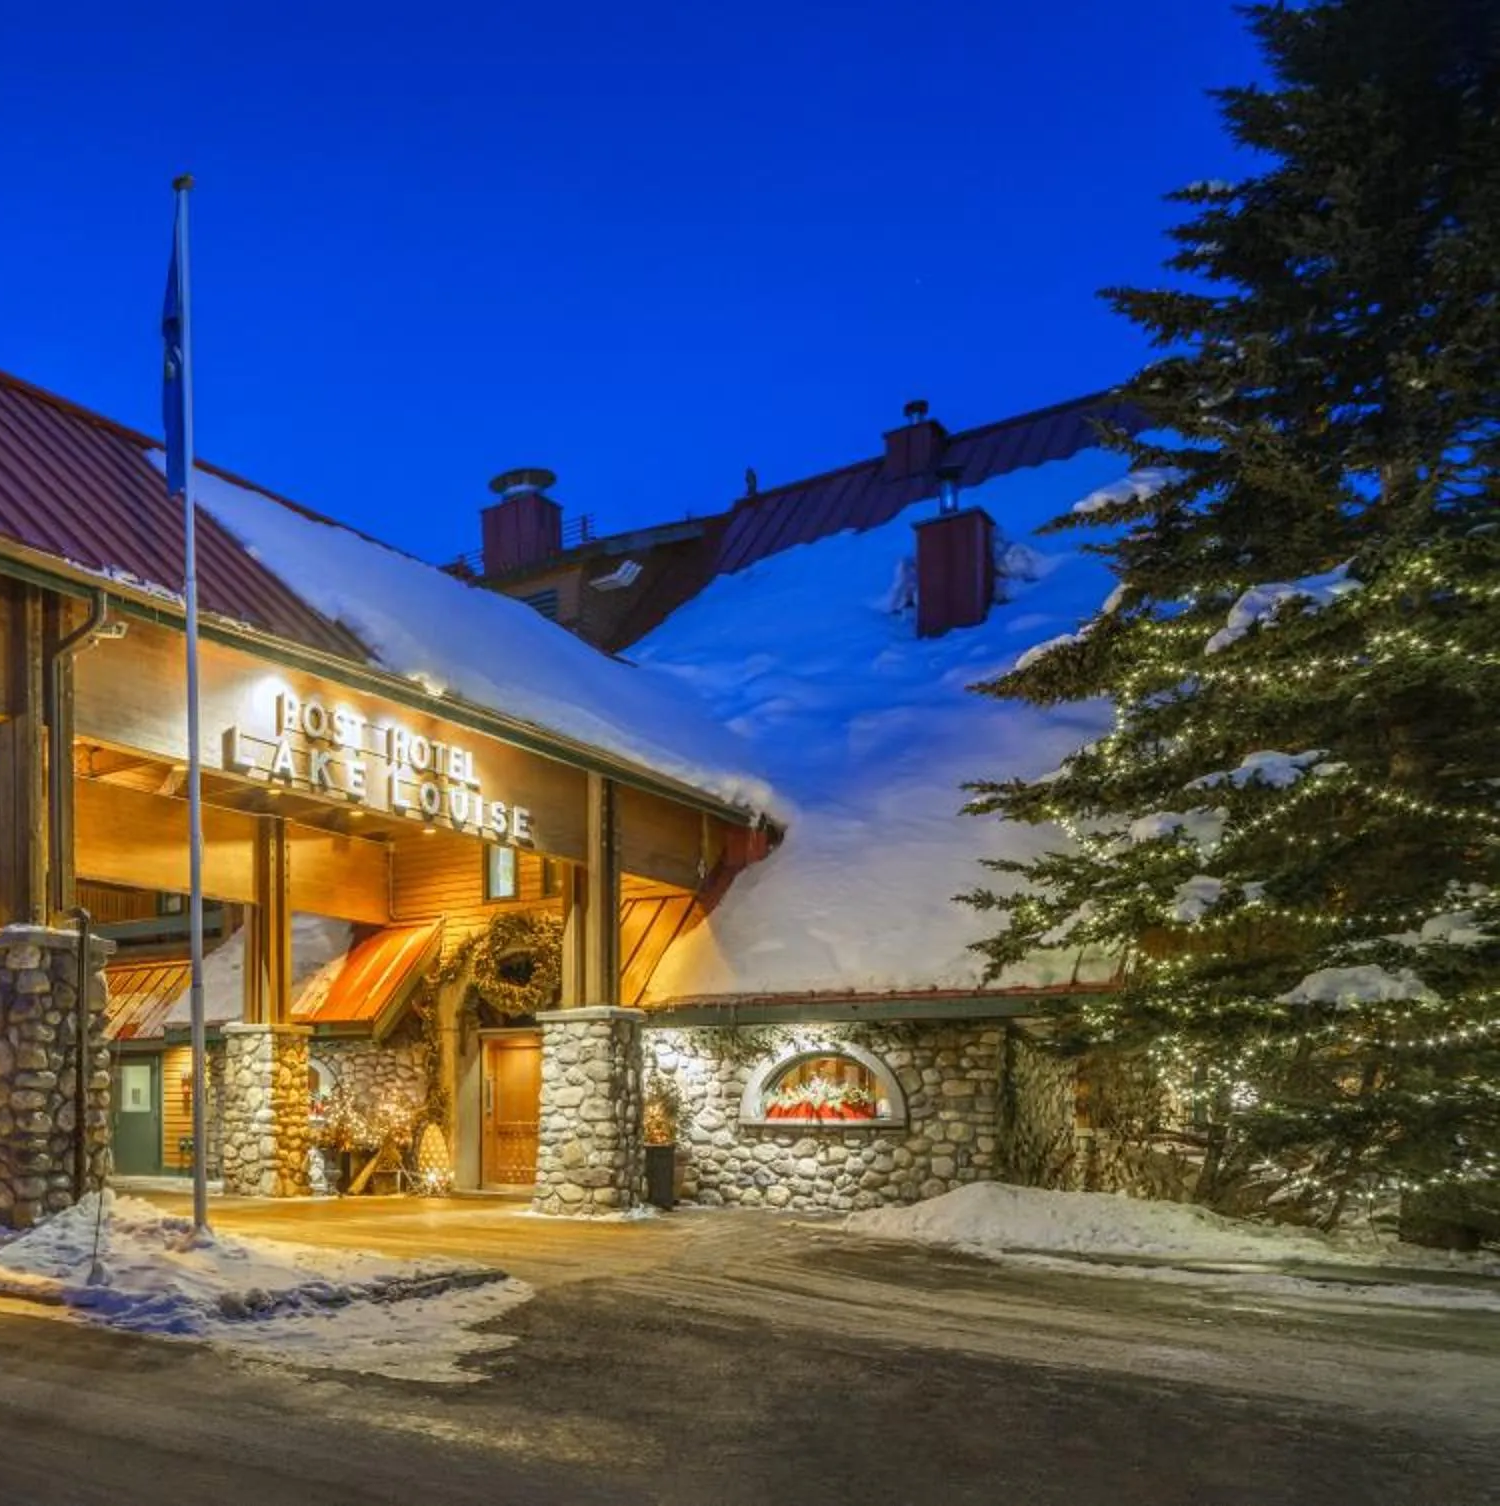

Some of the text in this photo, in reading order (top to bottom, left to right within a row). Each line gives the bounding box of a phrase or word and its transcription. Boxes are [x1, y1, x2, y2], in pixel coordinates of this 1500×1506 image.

[229, 726, 532, 839] LAKE LOUISE
[279, 693, 481, 785] POST HOTEL
